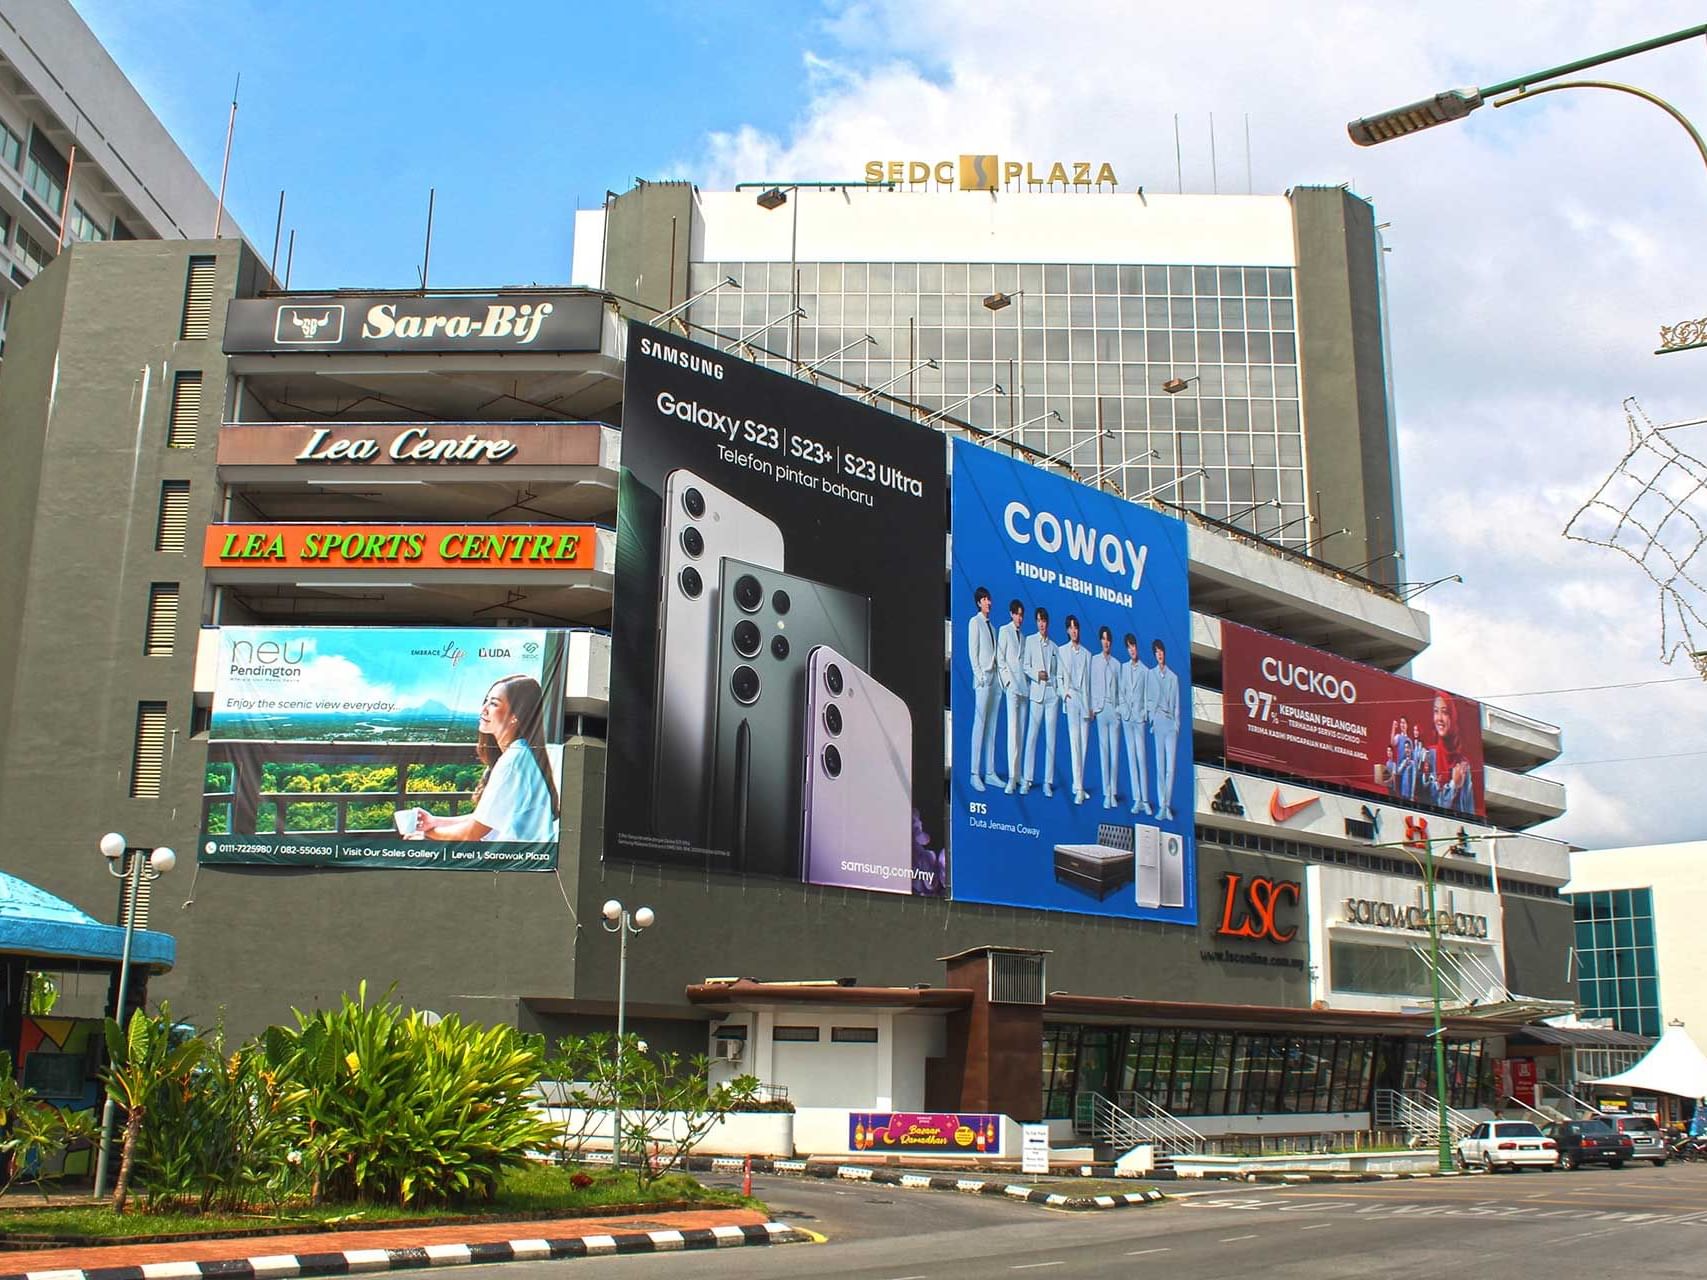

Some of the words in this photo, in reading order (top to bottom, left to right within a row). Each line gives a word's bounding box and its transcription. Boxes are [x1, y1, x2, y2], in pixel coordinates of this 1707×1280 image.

[865, 160, 954, 184] SEDC
[1004, 162, 1119, 185] PLAZA
[362, 303, 554, 344] Sara-Bif
[640, 338, 724, 380] SAMSUNG
[295, 428, 379, 461] Lea
[388, 427, 518, 461] Centre
[657, 392, 740, 440] Galaxy
[744, 420, 779, 449] S23
[790, 436, 833, 464] S23+
[844, 454, 876, 482] S23
[879, 465, 923, 497] Ultra
[718, 444, 772, 475] Telefon
[776, 466, 820, 489] pintar
[822, 478, 874, 508] baharu
[219, 533, 285, 559] LEA
[300, 533, 426, 560] SPORTS
[438, 533, 580, 561] CENTRE
[1016, 561, 1056, 584] HIDUP
[1059, 574, 1093, 596] LEBIH
[1096, 586, 1132, 608] INDAH
[232, 640, 304, 664] neu
[230, 665, 301, 678] Pendington
[1262, 656, 1357, 704] CUCKOO
[226, 698, 256, 710] Enjoy
[258, 699, 276, 709] the
[278, 700, 312, 709] scenic
[315, 700, 341, 710] view
[342, 701, 401, 712] everyday...
[1248, 724, 1268, 736] TERIMA
[1280, 704, 1321, 724] KEPUASAN
[1322, 716, 1367, 736] PELANGGAN
[1288, 720, 1317, 732] TERHADAP
[1318, 727, 1336, 738] SERVIS
[1337, 731, 1360, 744] CUCKOO
[970, 802, 987, 814] BTS
[1211, 800, 1244, 817] adidas
[970, 816, 988, 828] Duta
[988, 820, 1016, 832] Jenama
[1016, 824, 1040, 838] Coway
[219, 844, 272, 854] 0111-7225980
[280, 846, 332, 856] 082-550630
[342, 847, 362, 856] Visit
[364, 848, 380, 856] Our
[382, 848, 406, 858] Sales
[407, 850, 440, 860] Gallery
[452, 850, 475, 859] Level
[484, 850, 524, 860] Sarawak
[526, 852, 550, 860] Plaza
[840, 858, 934, 884] samsung.com/my
[1216, 874, 1300, 942] LSC
[900, 1134, 948, 1144] Ramadhan
[908, 1124, 941, 1135] Bazaar
